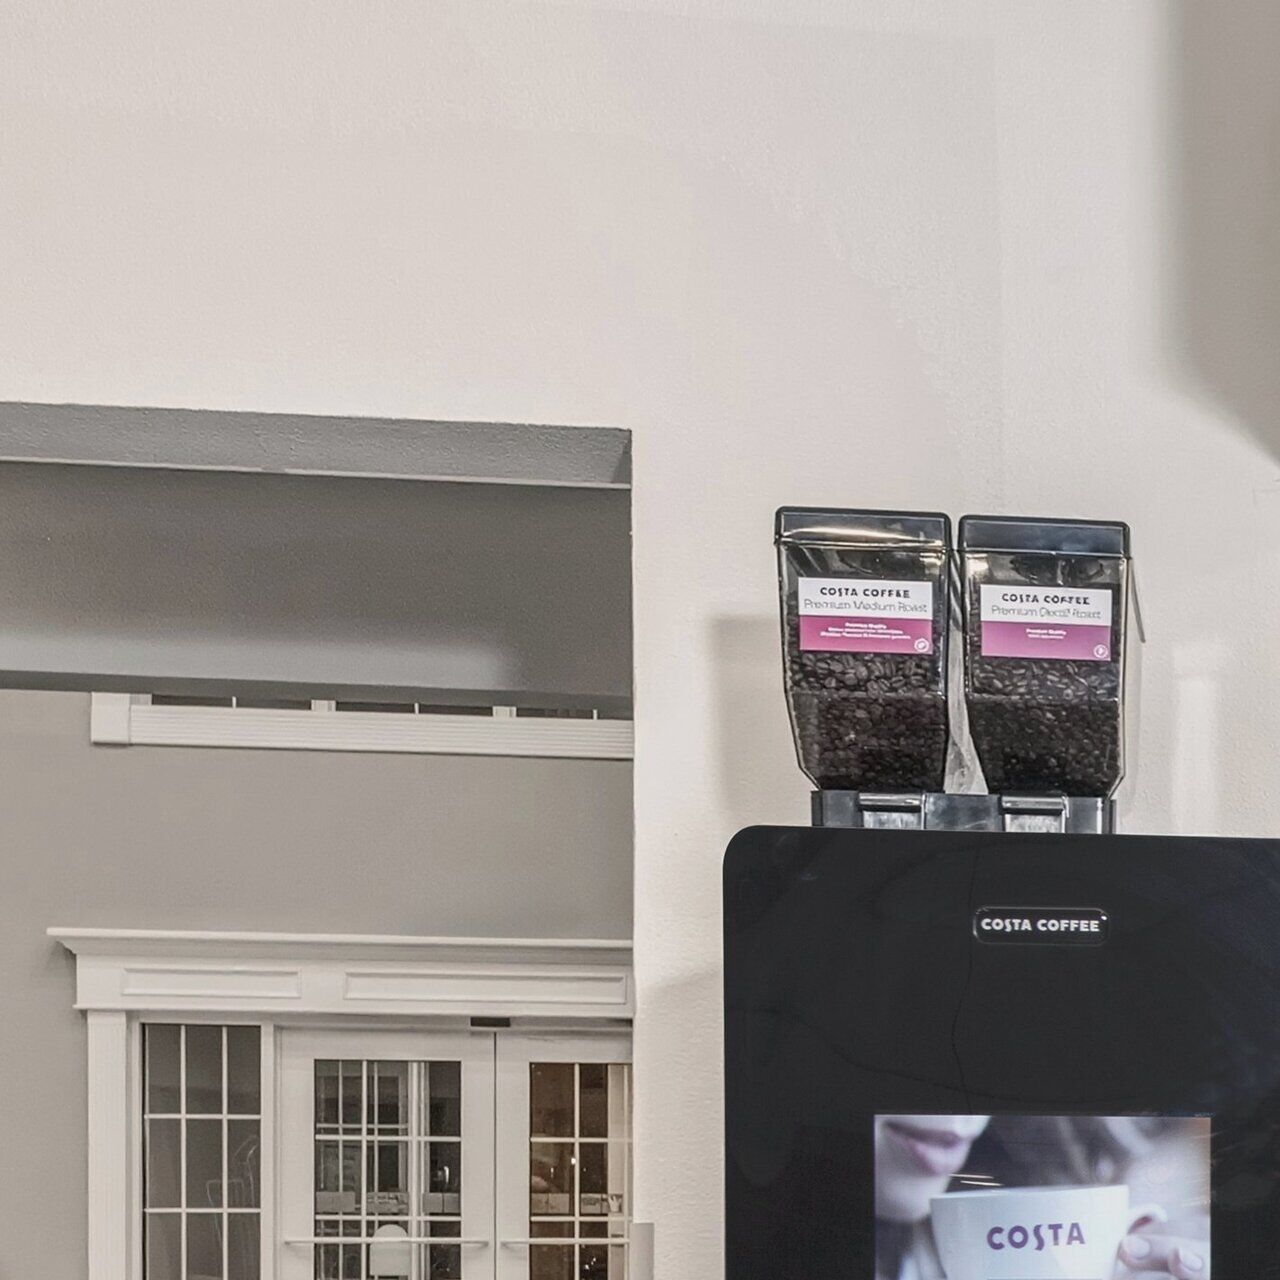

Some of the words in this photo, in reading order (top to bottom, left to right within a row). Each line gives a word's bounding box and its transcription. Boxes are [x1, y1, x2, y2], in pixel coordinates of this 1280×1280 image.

[820, 587, 858, 597] COSTA
[863, 588, 910, 598] COFFEE
[1001, 593, 1039, 603] COSTA
[1043, 595, 1090, 605] COFFEE
[981, 918, 1032, 932] COSTA
[1036, 919, 1100, 932] COFFEE
[986, 1222, 1085, 1251] COSTA
